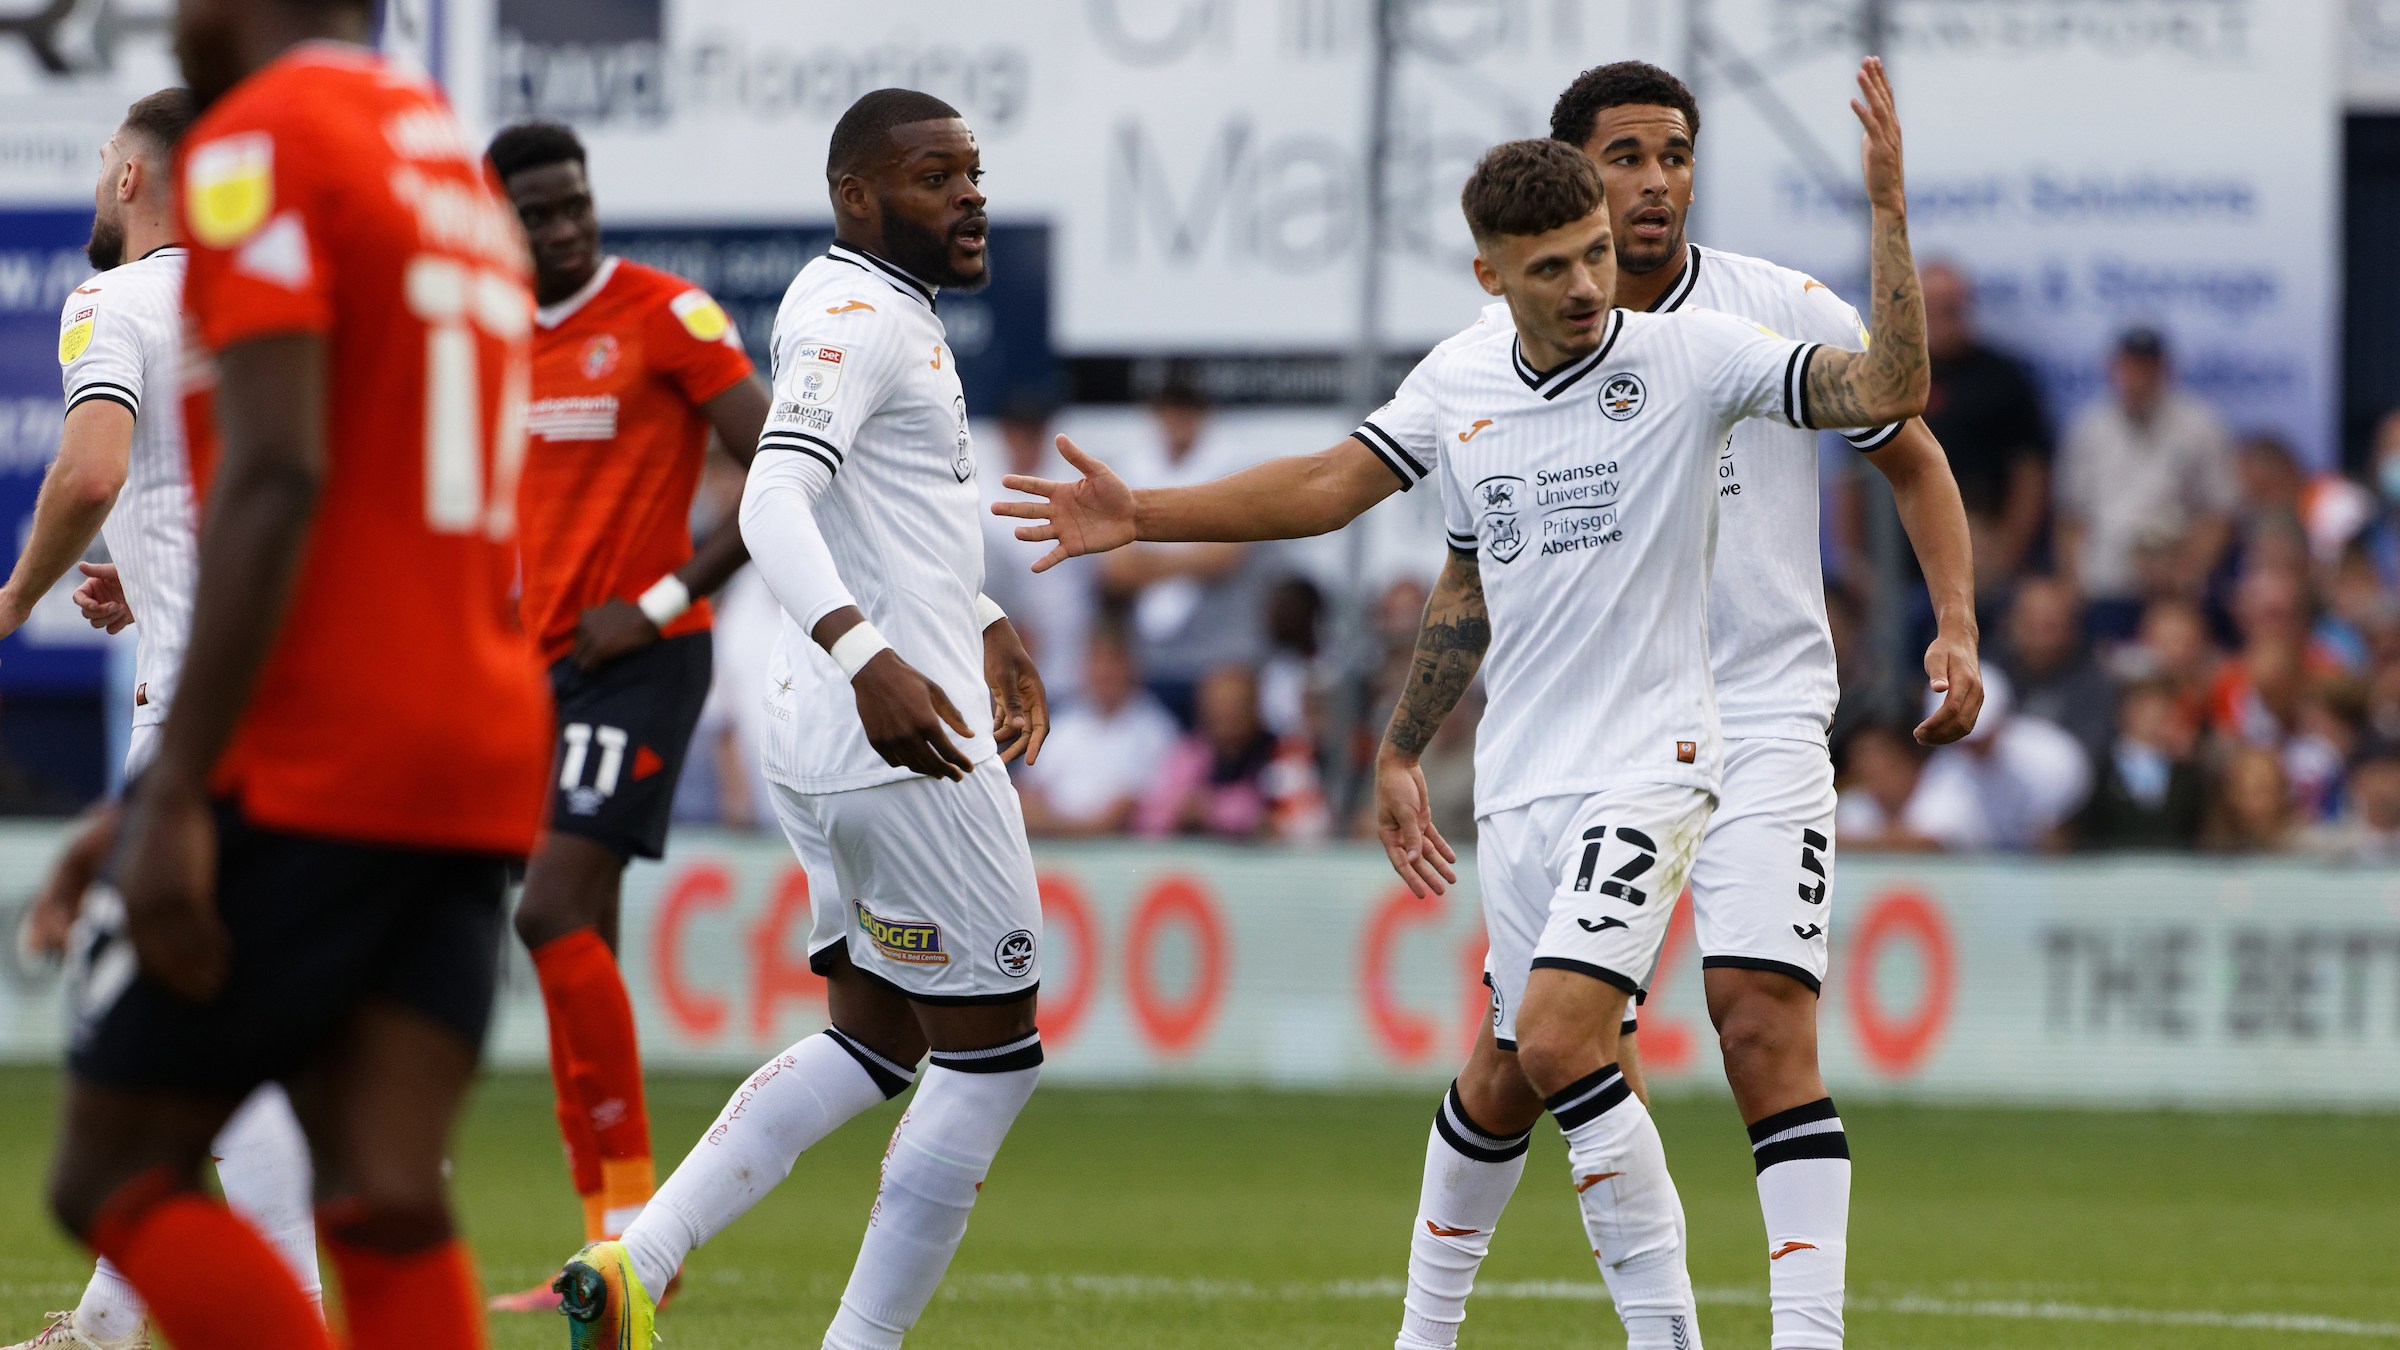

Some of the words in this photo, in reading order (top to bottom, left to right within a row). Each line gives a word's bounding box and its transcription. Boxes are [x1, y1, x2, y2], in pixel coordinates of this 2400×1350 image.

[76, 309, 93, 321] bet
[799, 361, 840, 371] CHAMPIONSHIP
[801, 348, 819, 359] sky
[820, 349, 841, 363] bet
[802, 391, 818, 400] EFL
[773, 414, 787, 423] OR
[787, 414, 807, 425] ANY
[808, 418, 829, 432] DAY
[777, 401, 798, 414] NOT
[798, 405, 833, 424] TODAY
[1536, 461, 1618, 486] Swansea
[1537, 481, 1620, 505] University
[1543, 508, 1618, 535] Prifysgol
[1541, 530, 1623, 556] Abertawe
[560, 722, 628, 798] 11
[1574, 825, 1657, 906] 12
[1798, 828, 1827, 905] 5
[860, 908, 935, 949] BUDGET
[2042, 924, 2194, 1042] THE
[728, 1091, 753, 1121] CITY
[708, 1124, 728, 1146] AFC
